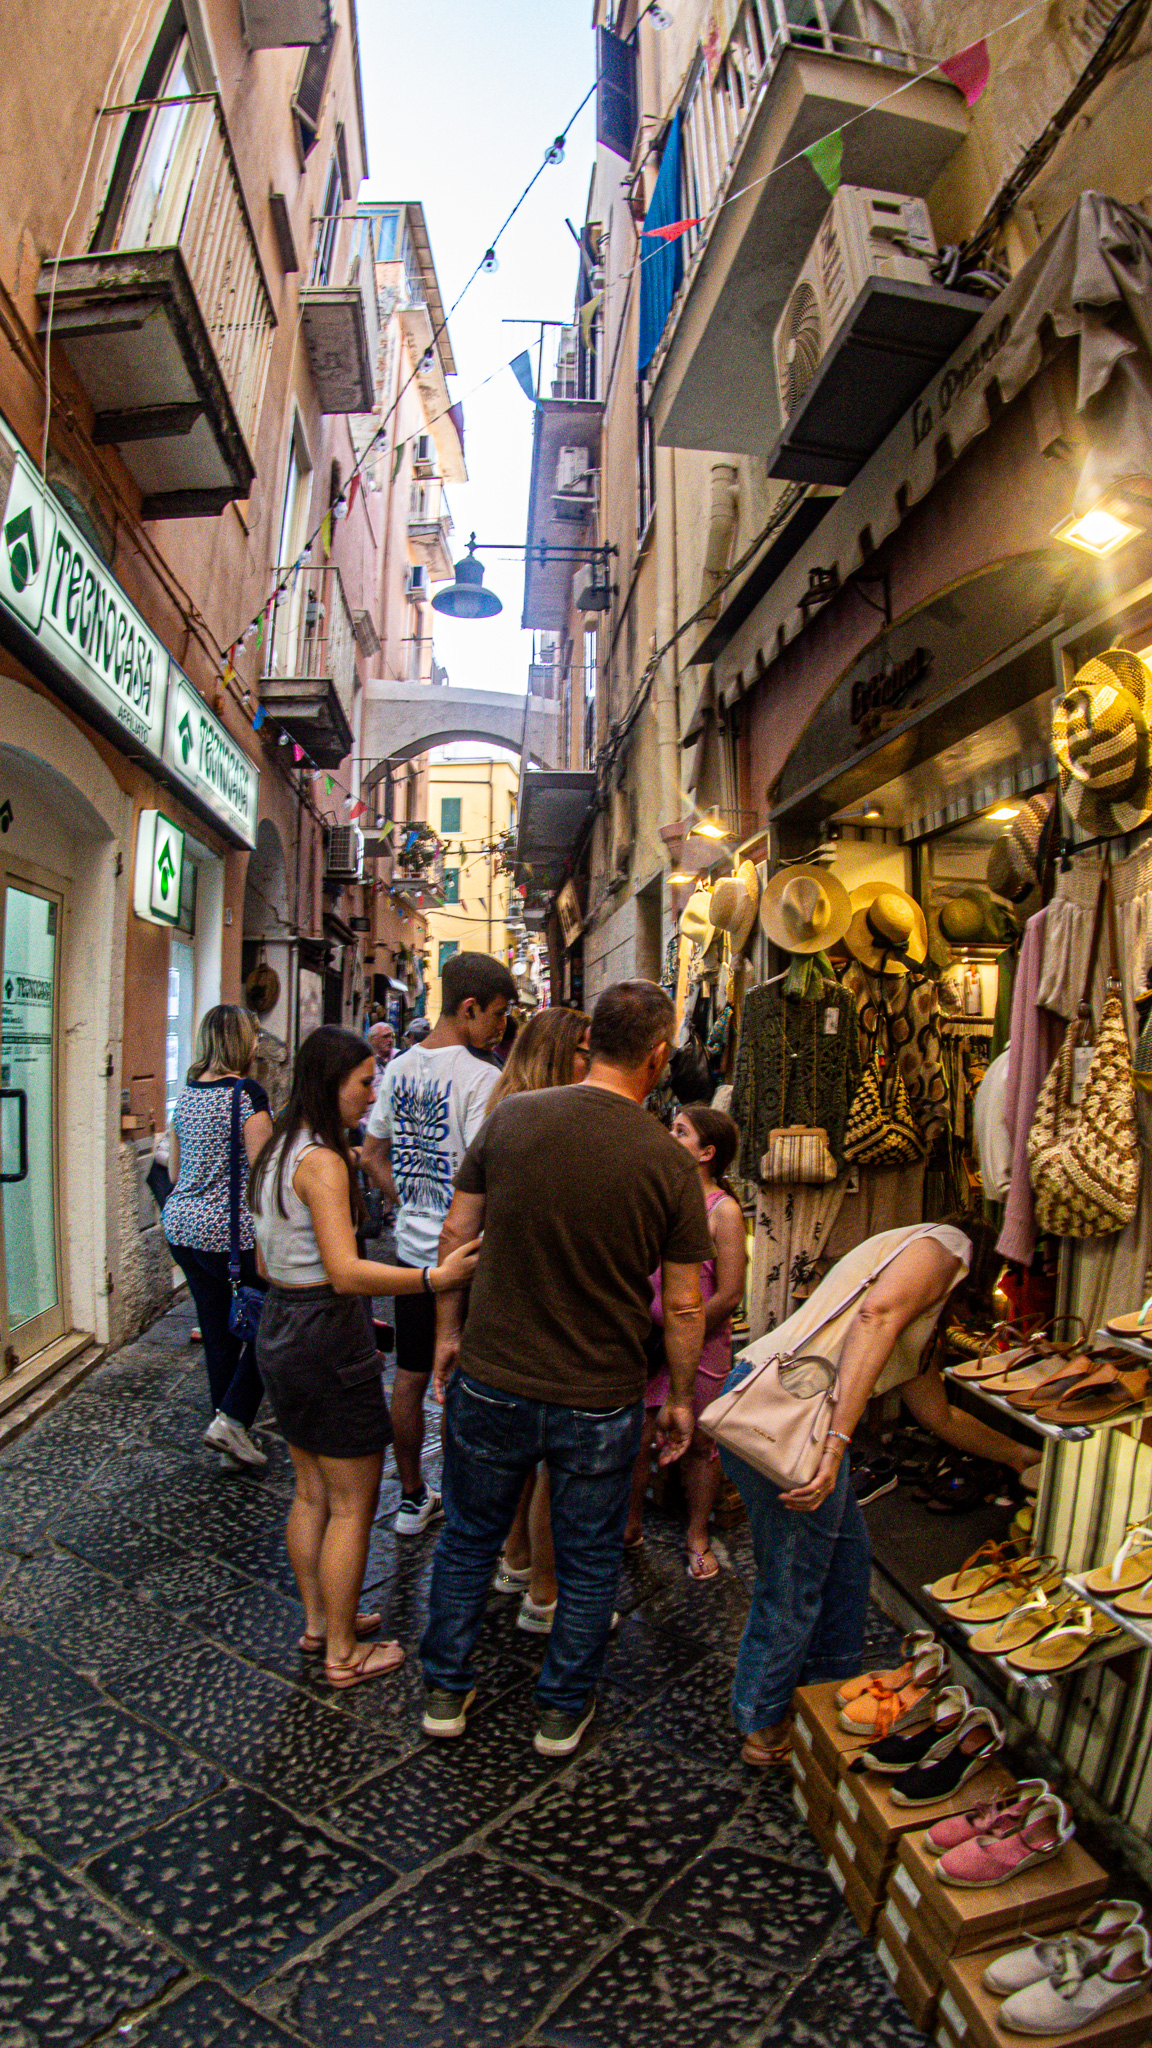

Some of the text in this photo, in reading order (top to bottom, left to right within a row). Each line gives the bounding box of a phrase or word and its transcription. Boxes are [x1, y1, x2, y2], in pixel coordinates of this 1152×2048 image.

[51, 530, 156, 718] TECNOCASA
[117, 704, 149, 745] AFFILIATO
[199, 715, 249, 818] TECNOCASA
